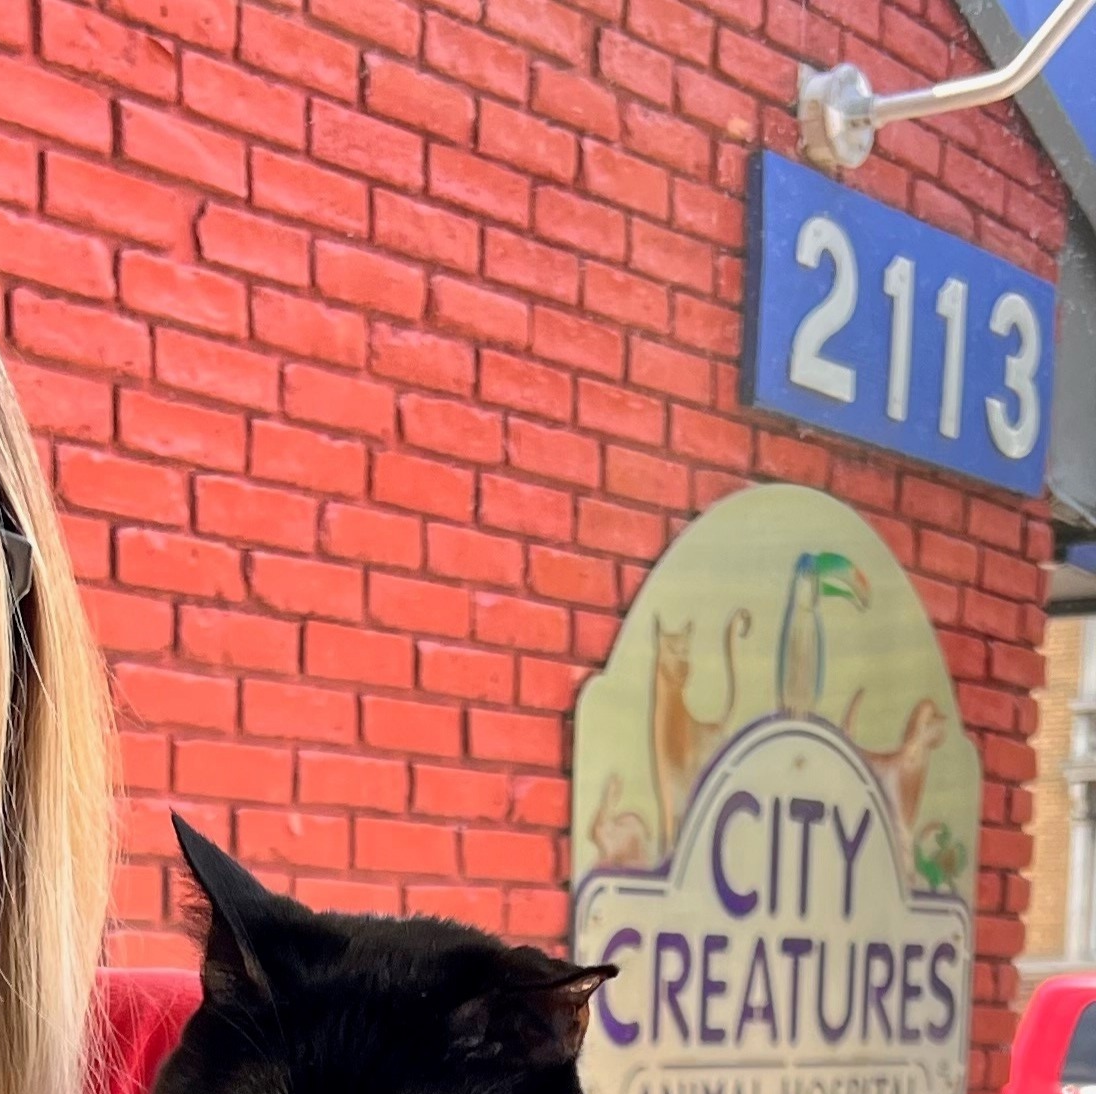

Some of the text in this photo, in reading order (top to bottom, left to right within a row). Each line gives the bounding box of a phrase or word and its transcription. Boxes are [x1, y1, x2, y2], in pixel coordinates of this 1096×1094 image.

[790, 216, 1042, 460] 2113
[711, 790, 871, 919] CITY
[596, 927, 957, 1047] CREATURES
